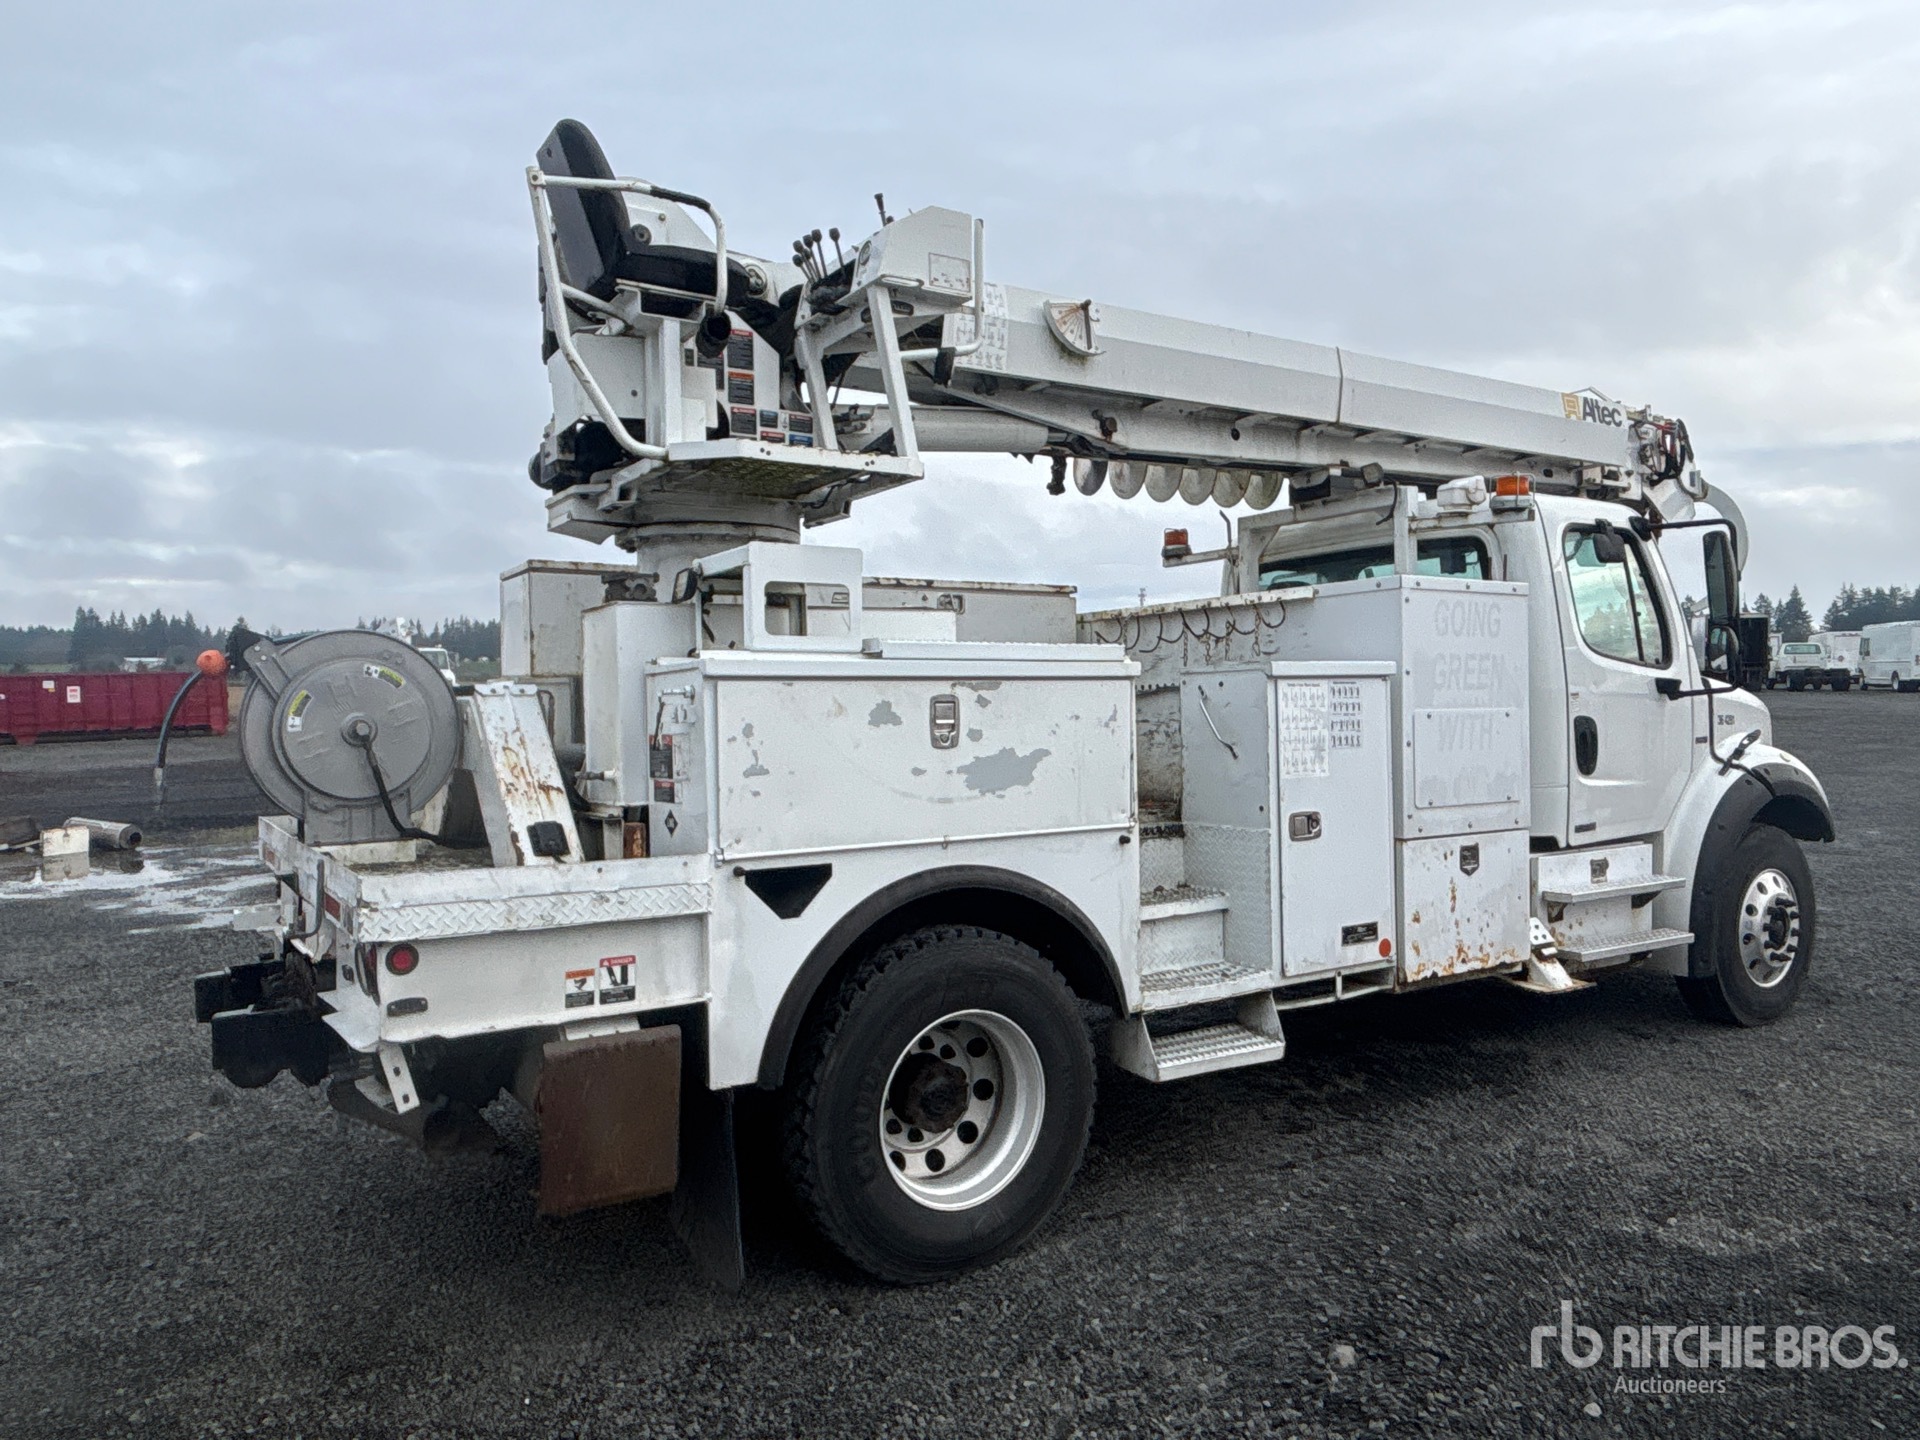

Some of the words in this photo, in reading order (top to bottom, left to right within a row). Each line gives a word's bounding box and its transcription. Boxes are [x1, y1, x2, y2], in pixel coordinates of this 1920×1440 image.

[1582, 396, 1623, 428] Altec
[1434, 599, 1501, 638] GOING
[1434, 652, 1506, 691] GREEN
[1438, 712, 1494, 752] WITH
